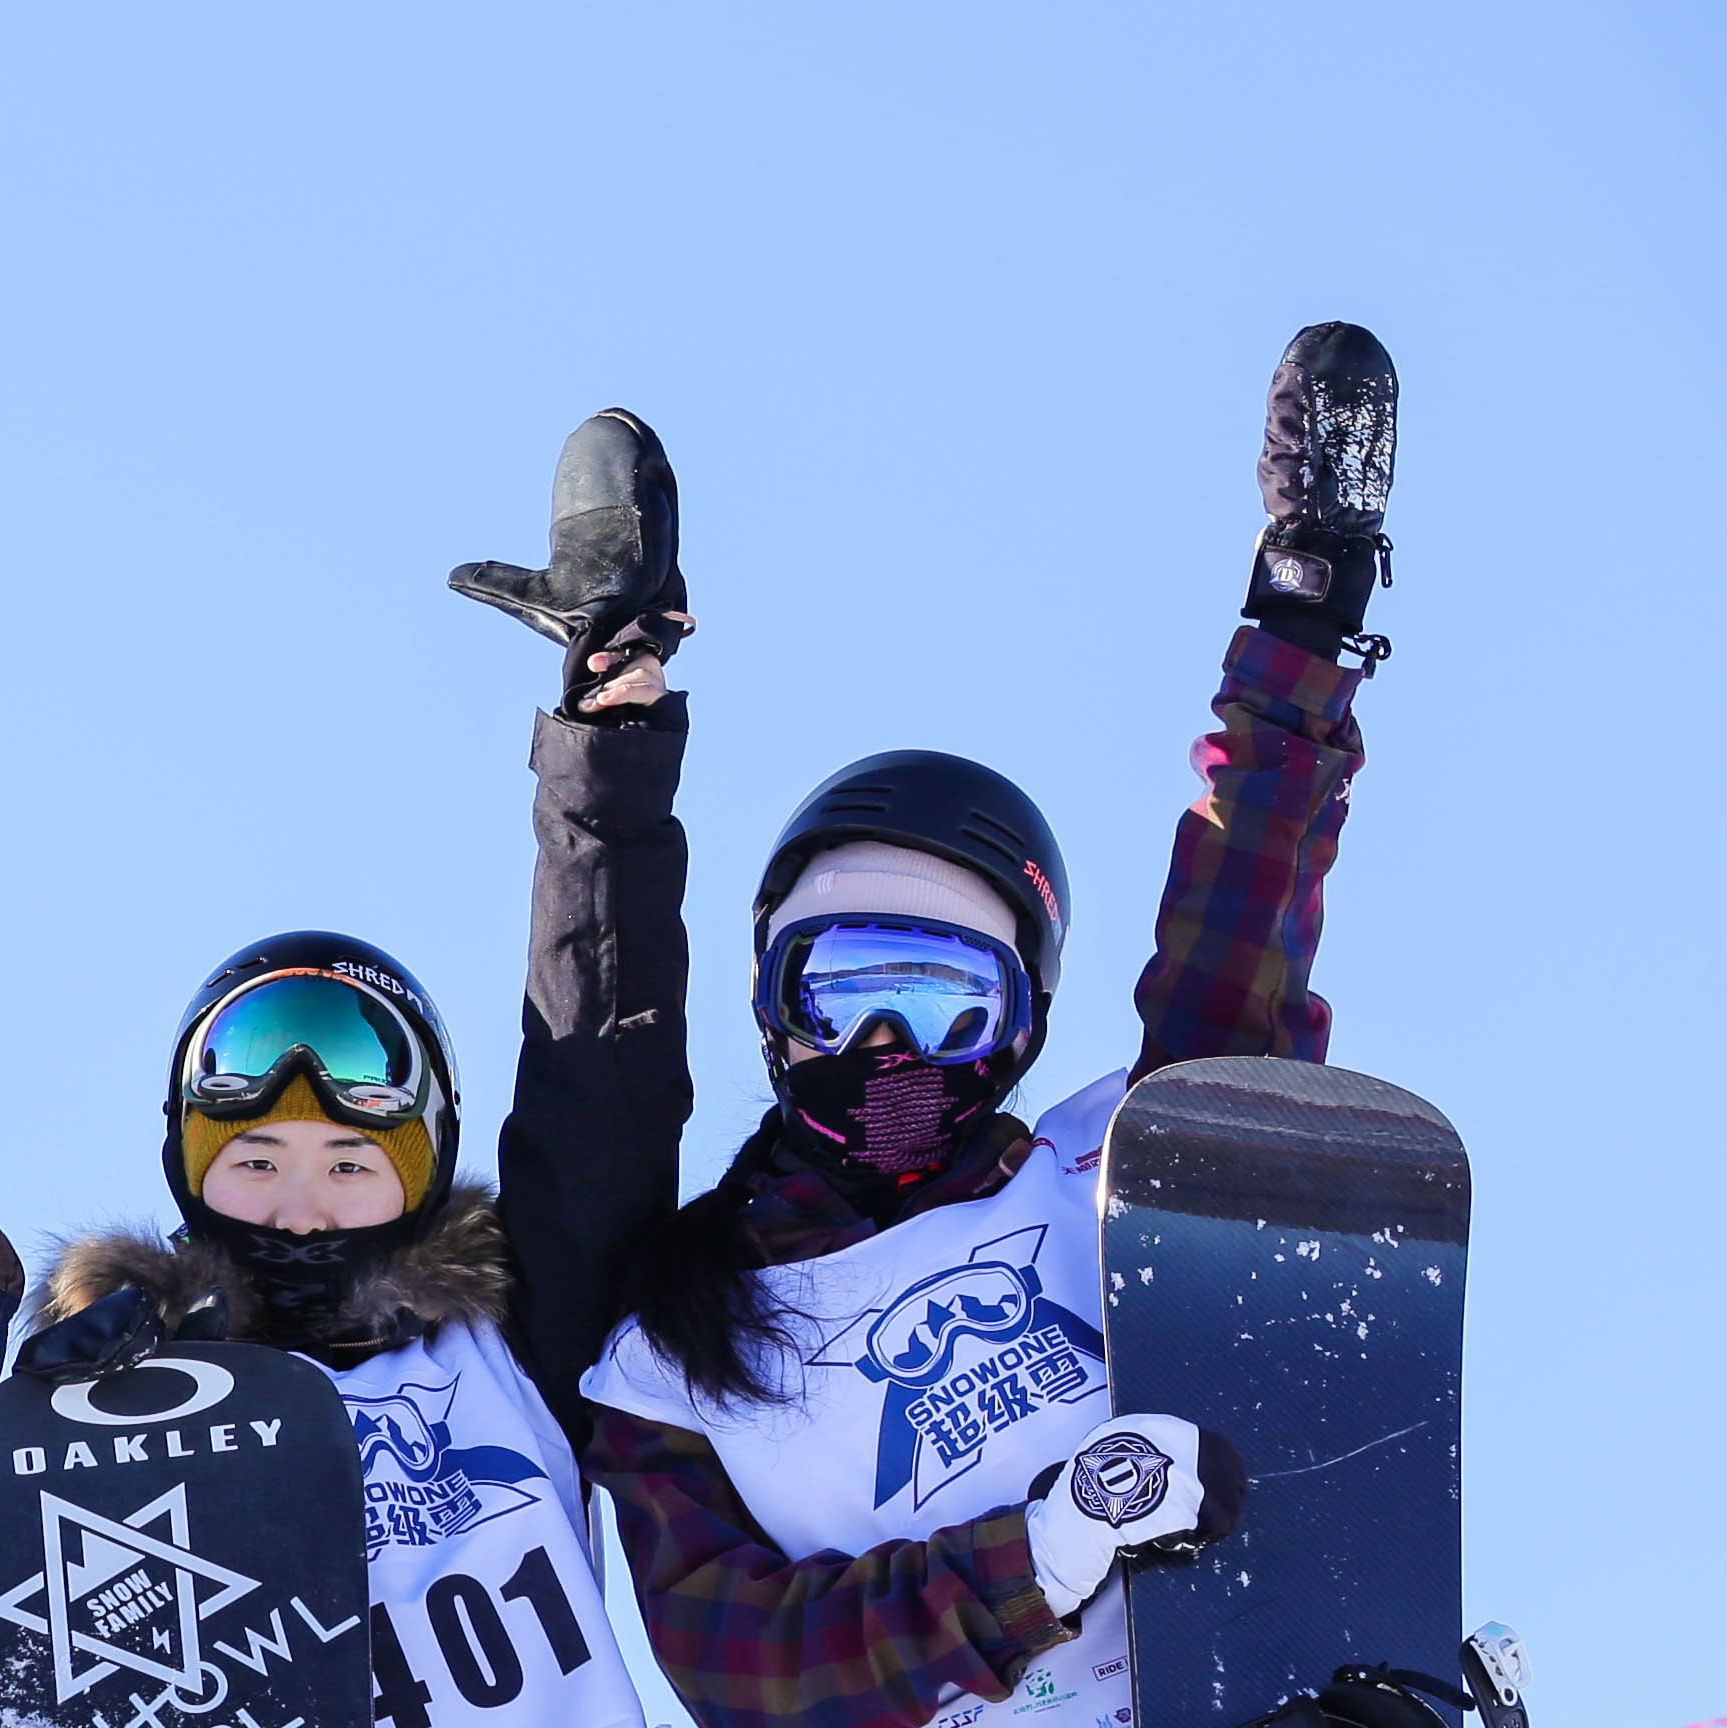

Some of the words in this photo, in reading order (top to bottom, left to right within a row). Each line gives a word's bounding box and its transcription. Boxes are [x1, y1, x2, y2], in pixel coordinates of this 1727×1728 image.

[332, 962, 405, 995] SHRED
[906, 1326, 1071, 1427] SNOWONE
[12, 1418, 282, 1476] OAKLEY
[86, 1568, 153, 1618] SNOW
[94, 1581, 175, 1639] FAMILY
[1098, 1660, 1125, 1678] RIDE
